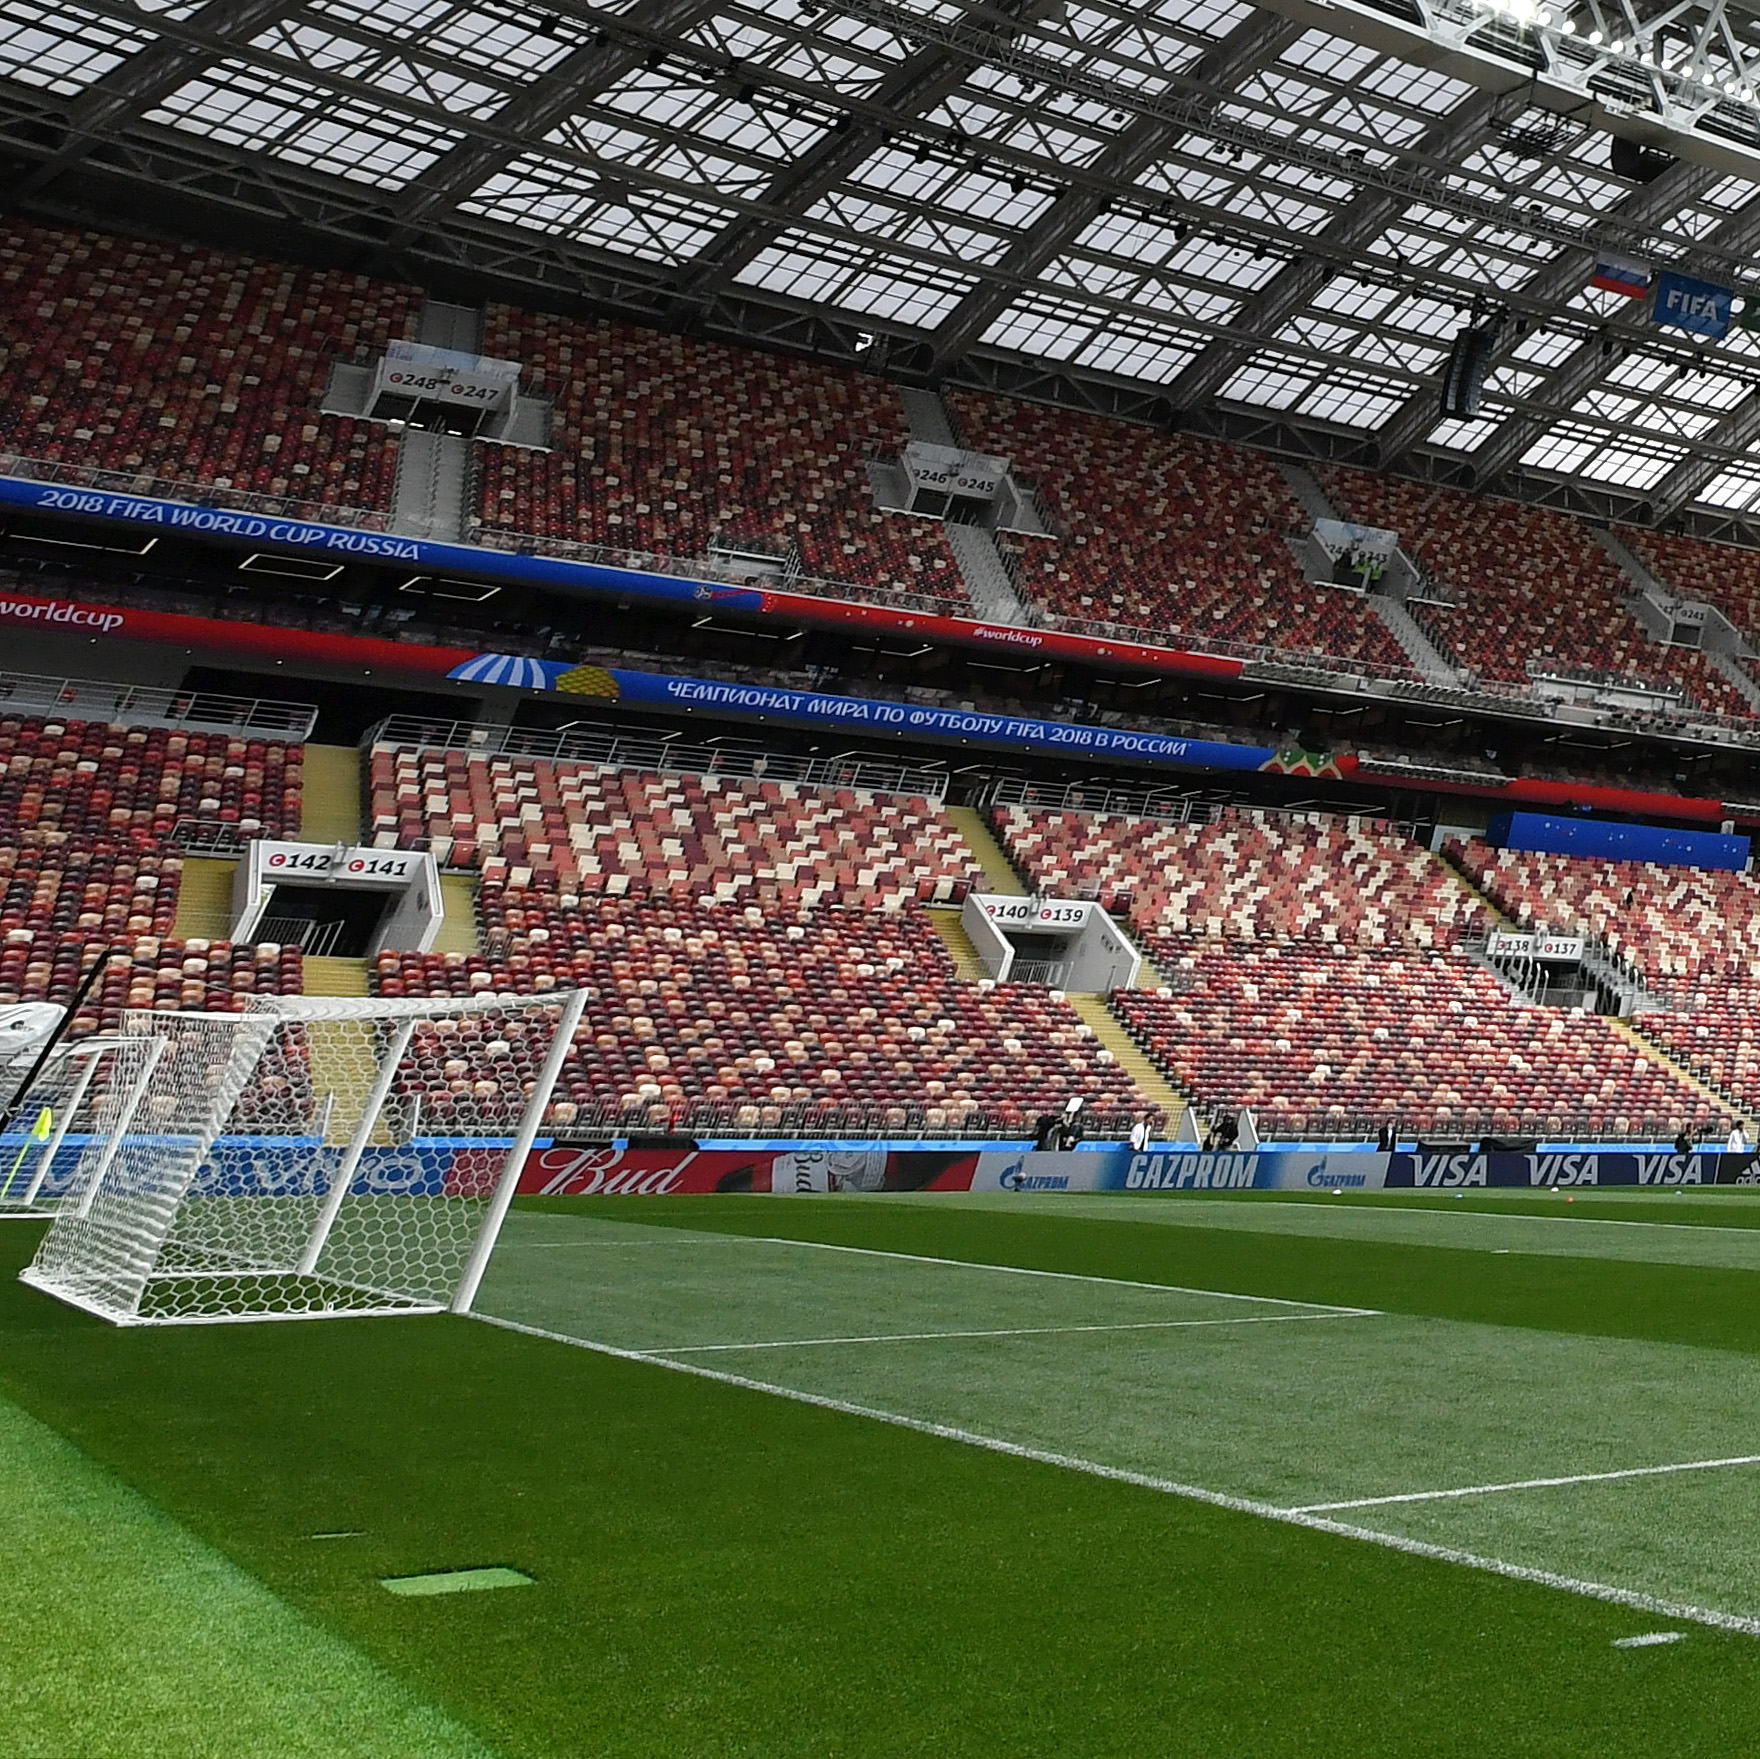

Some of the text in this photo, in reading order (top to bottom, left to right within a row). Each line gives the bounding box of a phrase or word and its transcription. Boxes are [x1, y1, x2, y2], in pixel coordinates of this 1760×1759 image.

[1666, 290, 1719, 321] FIFA
[36, 489, 421, 560] 2018 FIFA WORLD CUP RUSSIA
[973, 627, 1043, 648] #worldcup
[667, 681, 1187, 756] ЧЕМПИОНАТ МИРА ПО ФУТБОЛУ FIFA 2018 В РОССИИ
[540, 1148, 699, 1195] Bud
[1125, 1155, 1260, 1188] GAZPROM
[1322, 1174, 1366, 1188] GAZPROM
[1408, 1154, 1487, 1186] VISA
[1524, 1154, 1599, 1185] VISA
[1632, 1154, 1702, 1184] VISA
